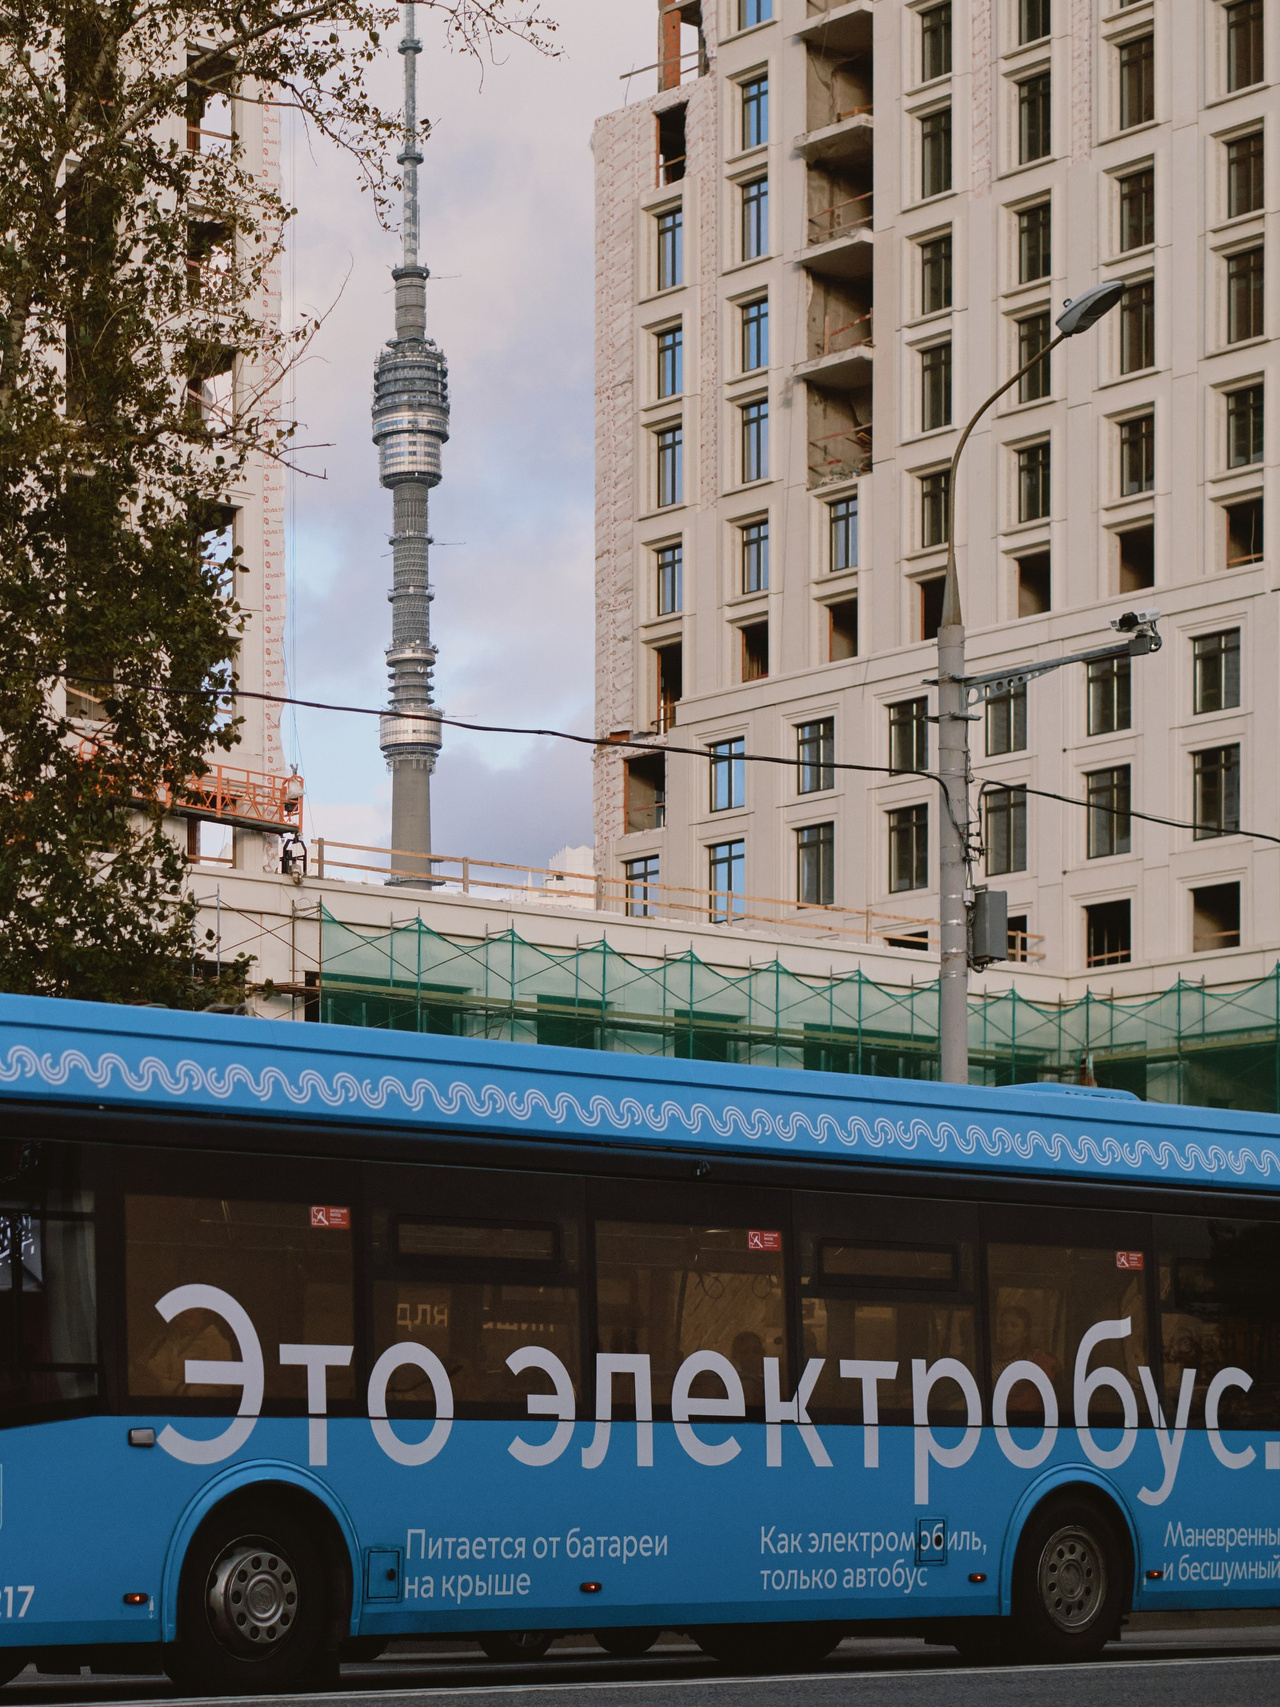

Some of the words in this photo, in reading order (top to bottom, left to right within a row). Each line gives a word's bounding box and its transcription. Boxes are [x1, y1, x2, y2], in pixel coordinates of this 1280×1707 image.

[154, 1283, 454, 1466] Это
[406, 1528, 526, 1560] Питается
[533, 1534, 561, 1559] от
[566, 1527, 669, 1564] батареи
[760, 1526, 803, 1554] Как
[404, 1575, 434, 1599] на
[442, 1571, 531, 1604] крыше
[760, 1568, 837, 1591] только
[842, 1558, 928, 1594] автобус
[1163, 1562, 1173, 1581] и
